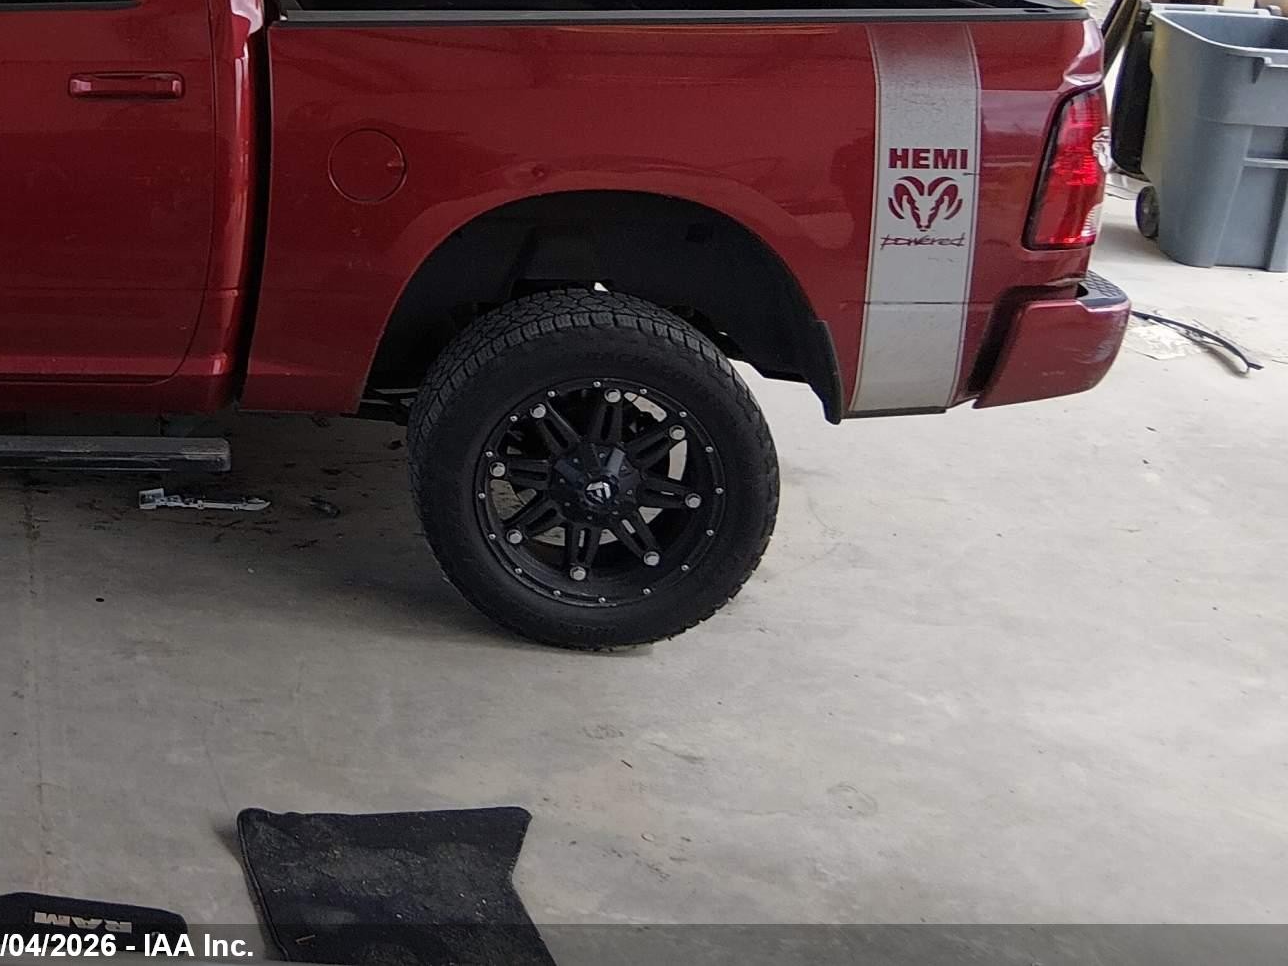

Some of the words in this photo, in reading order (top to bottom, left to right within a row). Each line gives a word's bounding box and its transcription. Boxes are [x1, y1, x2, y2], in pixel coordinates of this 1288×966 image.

[888, 148, 969, 169] HEMI
[880, 233, 965, 250] powered
[34, 911, 132, 933] RAM
